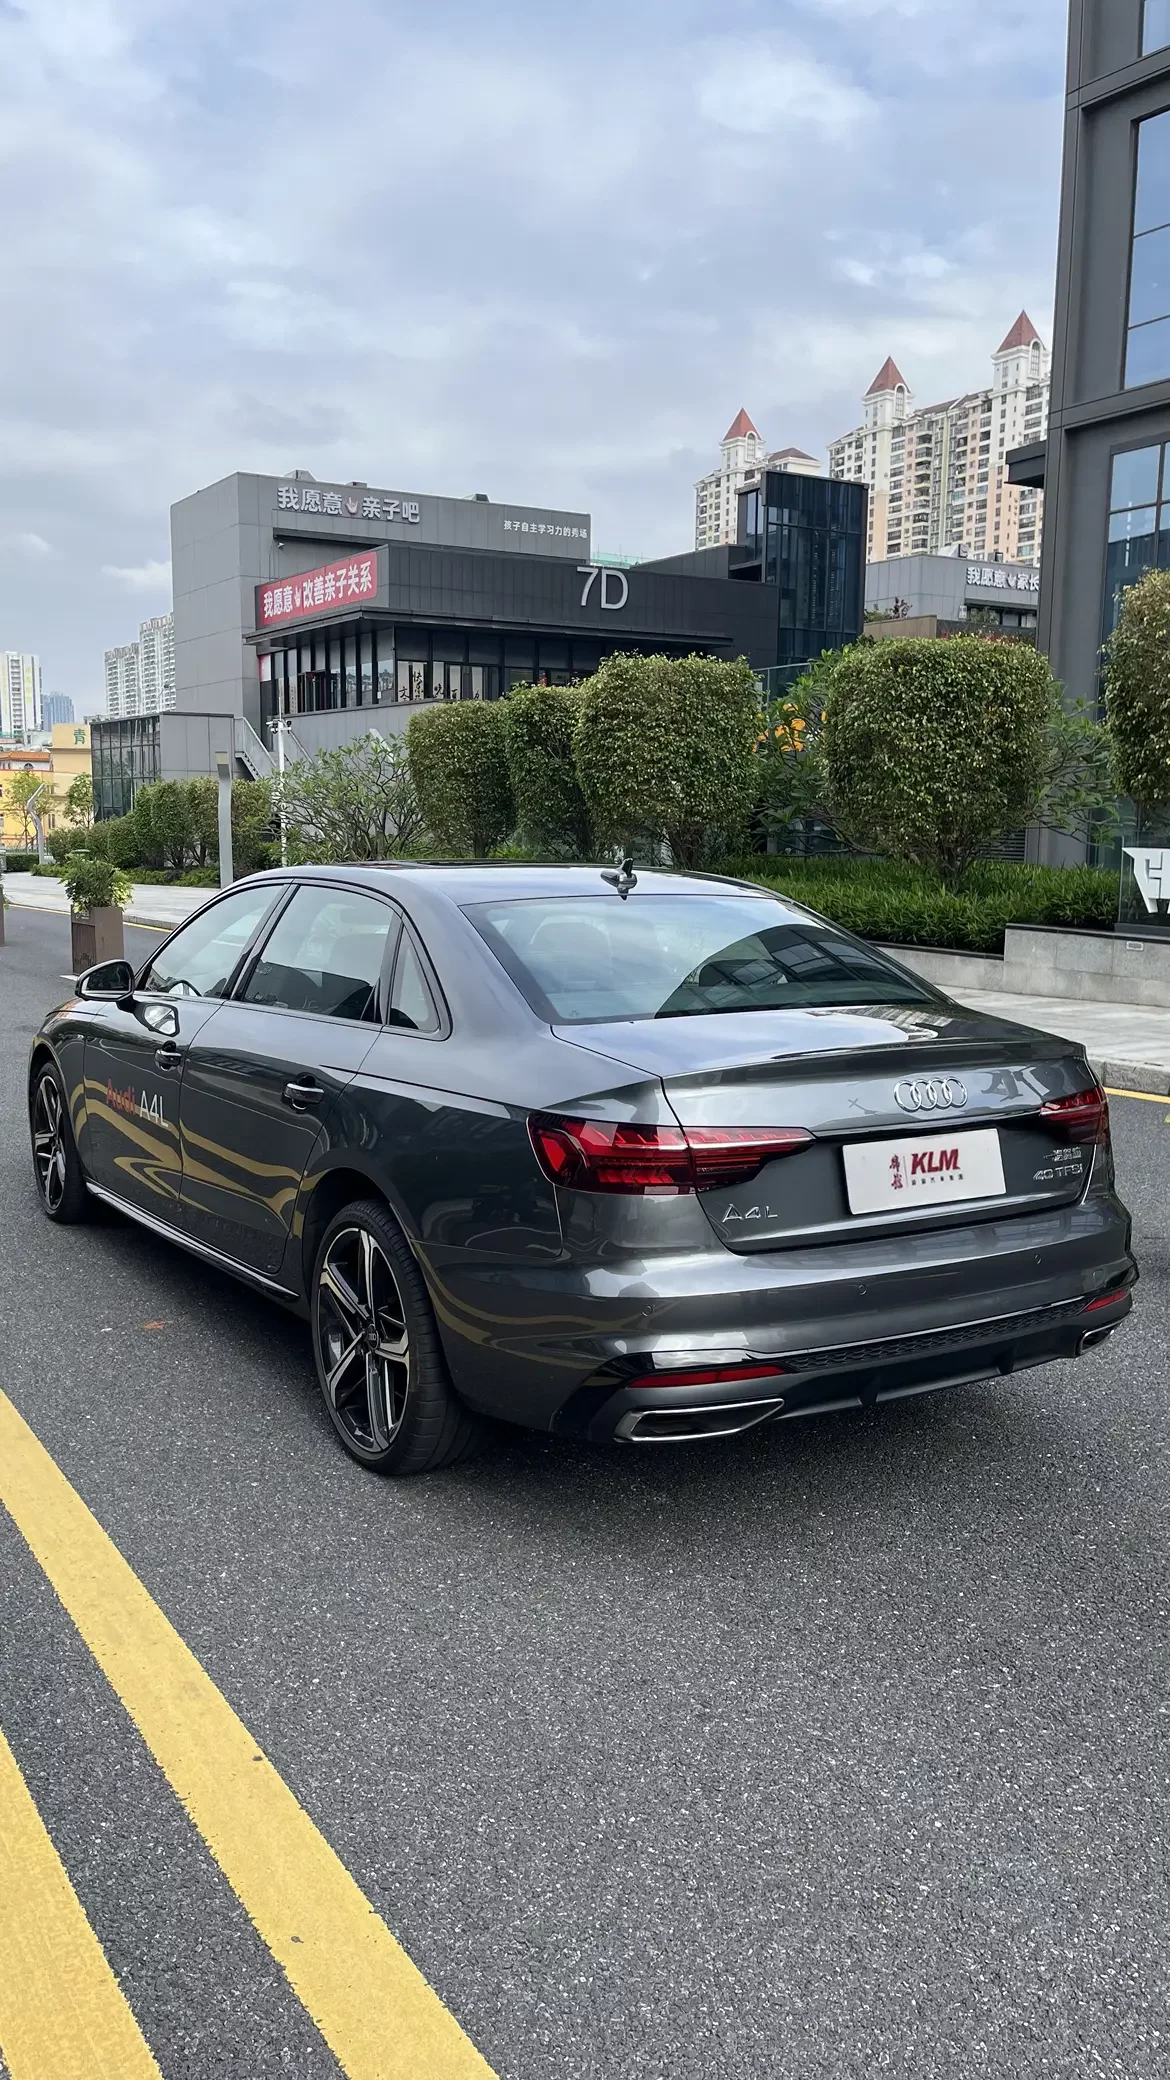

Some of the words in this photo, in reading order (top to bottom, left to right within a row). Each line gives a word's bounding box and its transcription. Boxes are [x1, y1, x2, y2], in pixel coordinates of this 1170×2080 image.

[277, 486, 343, 515] 我愿意
[362, 496, 420, 523] 亲子吧
[263, 585, 293, 619] 我愿意
[302, 560, 372, 608] 改善亲子关系
[576, 566, 629, 610] 7D
[967, 566, 1006, 588] 我愿意
[73, 728, 86, 745] 青
[105, 1078, 136, 1115] Audi
[139, 1090, 169, 1128] A4L
[911, 1148, 960, 1175] KLM
[1033, 1168, 1054, 1180] 40
[721, 1203, 779, 1223] A4L
